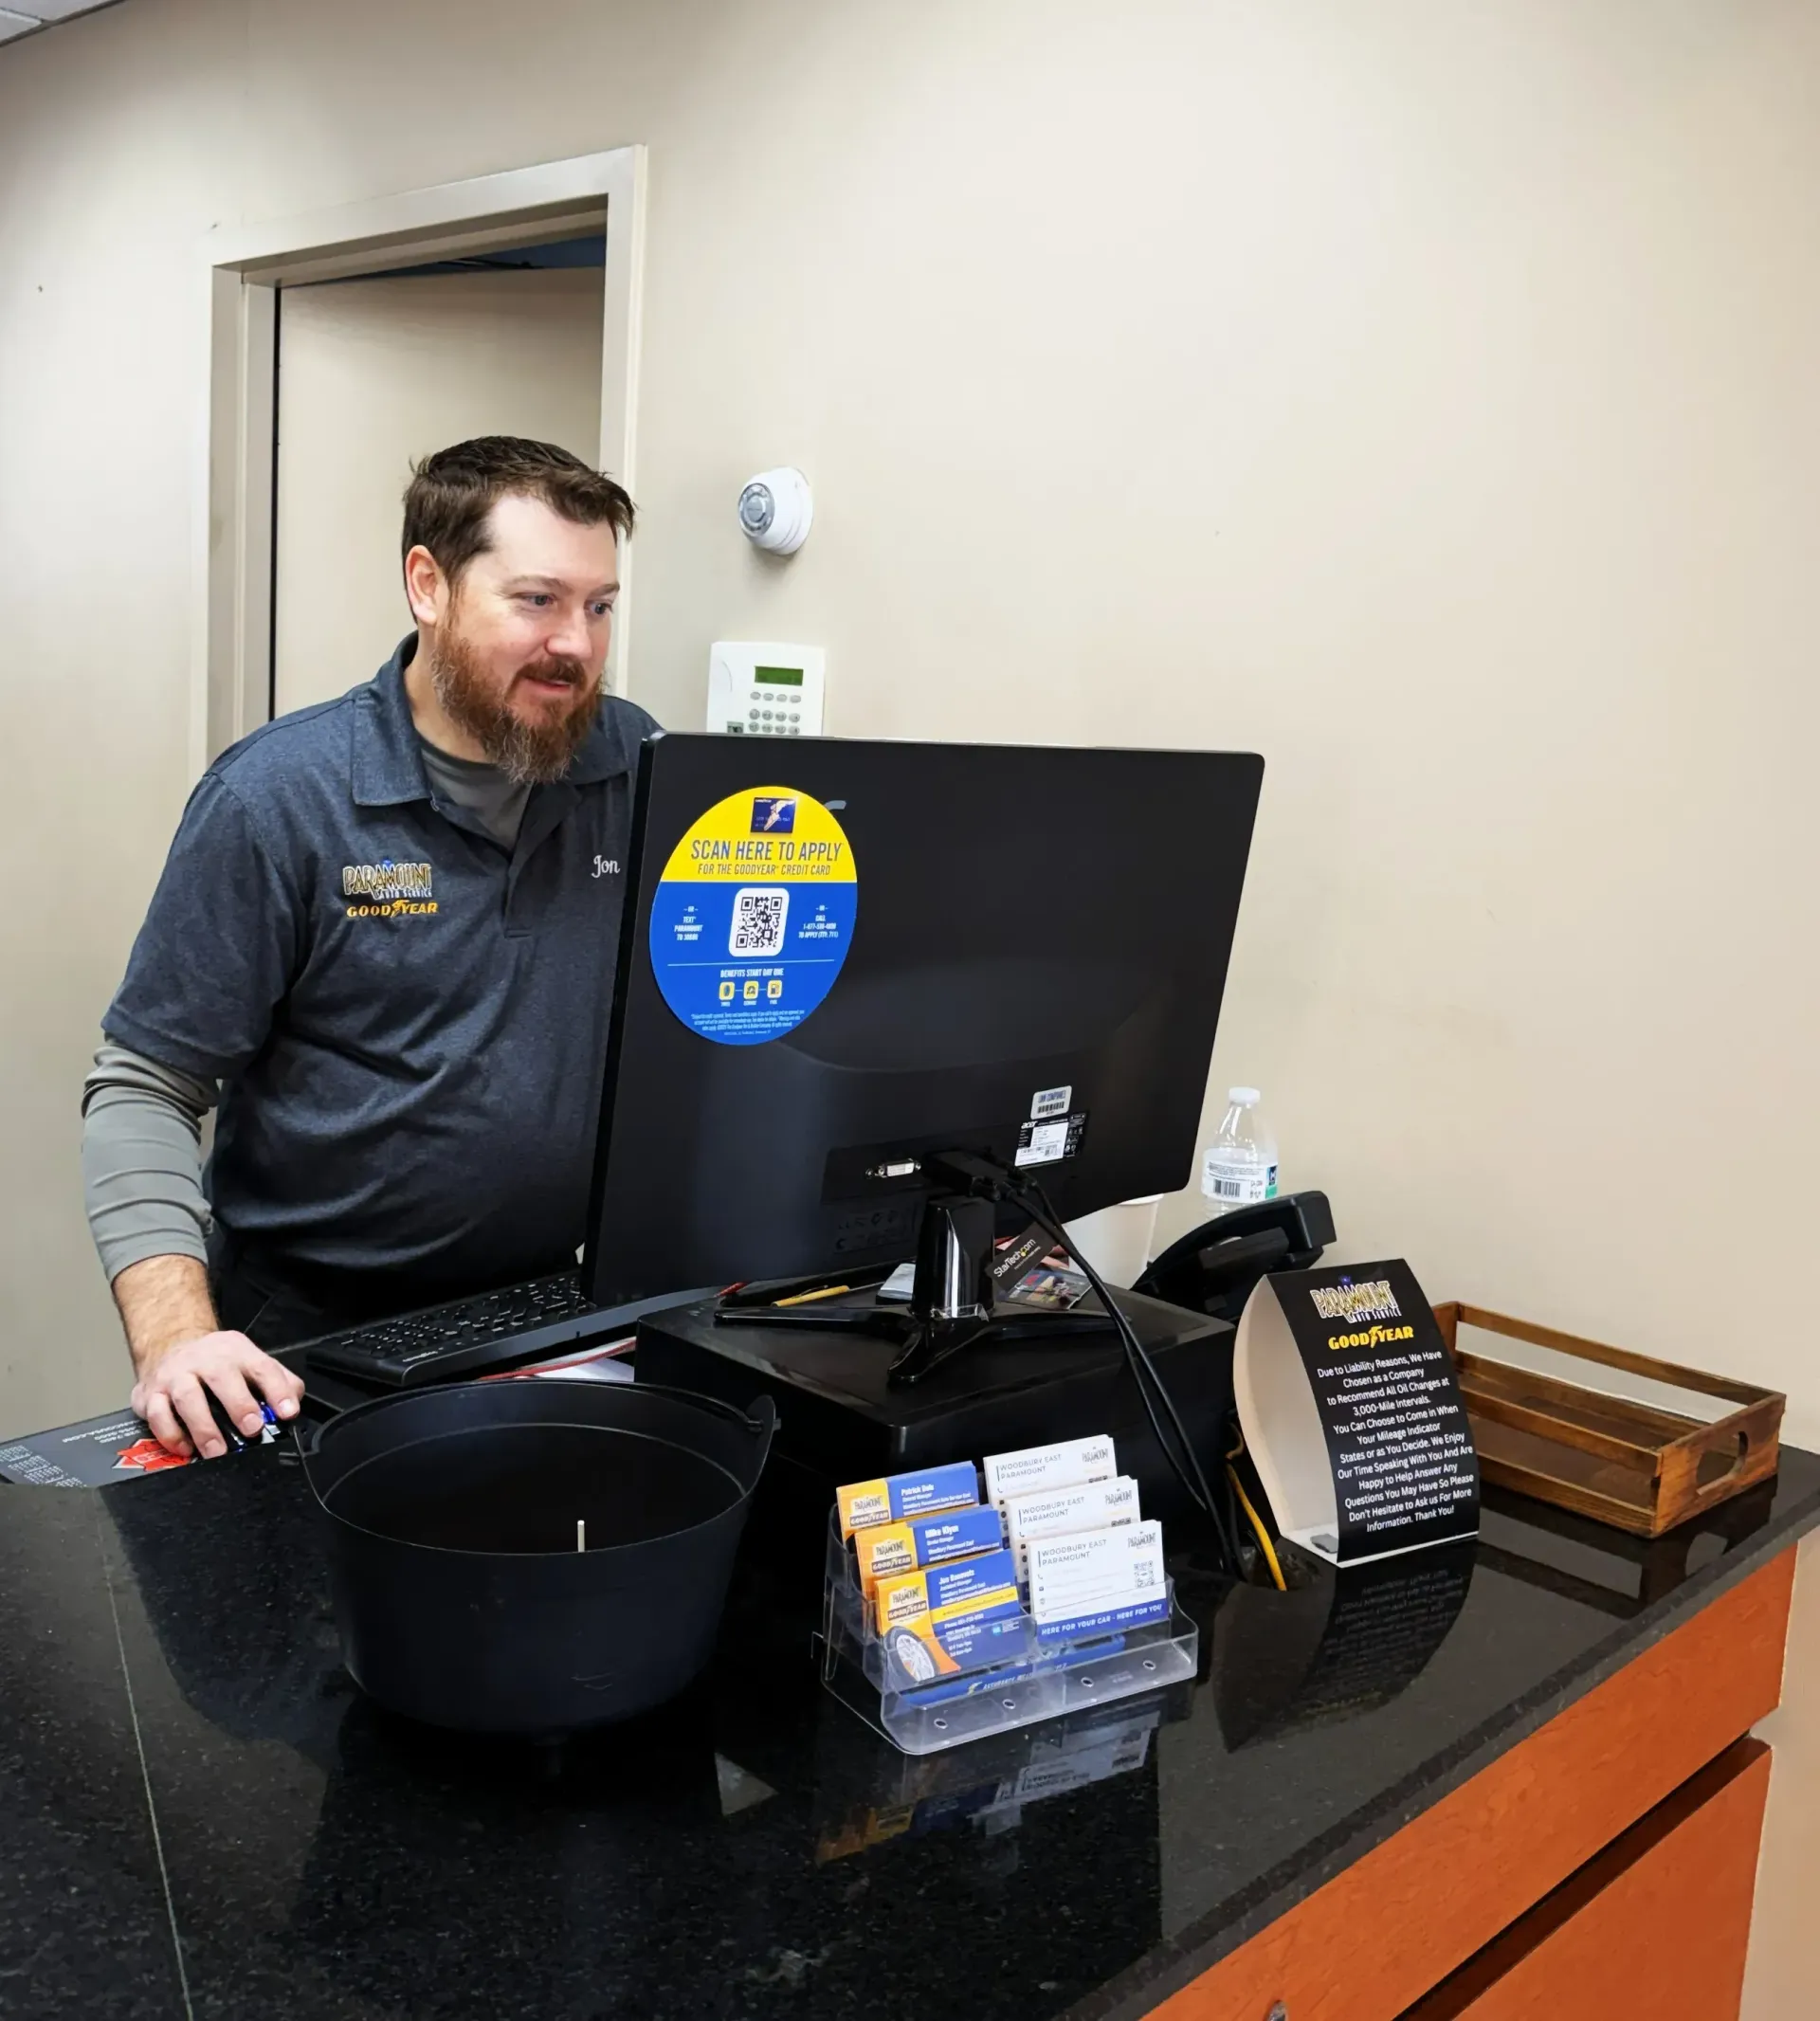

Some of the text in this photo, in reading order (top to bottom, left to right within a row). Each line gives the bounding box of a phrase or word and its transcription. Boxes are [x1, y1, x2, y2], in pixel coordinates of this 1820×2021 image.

[691, 840, 842, 861] SCAN HERE TO APPLY
[592, 855, 620, 878] Jon
[698, 864, 714, 875] FOR
[718, 865, 731, 875] THE
[781, 865, 809, 875] CREDIT
[810, 865, 830, 875] CARD
[343, 864, 432, 900] PARAMOUNT
[347, 900, 438, 918] GOODYEAR
[1310, 1281, 1399, 1324] PARAMOUNT
[1328, 1325, 1414, 1350] GOODYEAR
[1318, 1350, 1442, 1378] Due to Liability Reasons, We Have
[1343, 1376, 1372, 1388] Chosen
[1389, 1368, 1425, 1380] Company
[1327, 1377, 1449, 1406] to Recommend All Oil Changes at
[1353, 1394, 1431, 1417] 3,000-Mile Intervals.
[1334, 1405, 1458, 1435] You Can Choose to Come in When
[1357, 1422, 1441, 1445] Your Mileage Indicator
[1340, 1451, 1365, 1464] States
[1367, 1450, 1374, 1459] or
[1386, 1445, 1401, 1454] You
[1402, 1439, 1430, 1452] Decide.
[1430, 1437, 1443, 1447] We
[1445, 1432, 1465, 1445] Enjoy
[1000, 1454, 1062, 1470] WOODBURY EAST
[1001, 1466, 1046, 1479] PARAMOUNT
[1338, 1445, 1473, 1480] Our Time Speaking With You And Are
[1358, 1463, 1457, 1490] Happy to Help Answer Any
[1345, 1473, 1474, 1509] Questions You May Have So Please
[1022, 1497, 1084, 1514] WOODBURY EAST
[1024, 1509, 1068, 1523] PARAMOUNT
[1349, 1510, 1370, 1522] Don't
[1372, 1503, 1403, 1517] Hesitate
[1405, 1502, 1413, 1511] to
[1414, 1498, 1428, 1508] Ask
[1439, 1492, 1450, 1502] For
[1452, 1488, 1472, 1500] More
[1367, 1505, 1454, 1532] Information. Thank You!
[1043, 1539, 1106, 1557] WOODBURY EAST
[1043, 1552, 1090, 1565] PARAMOUNT
[888, 1602, 926, 1619] GOODYEAR
[1042, 1626, 1060, 1635] HERE
[1078, 1619, 1095, 1628] YOUR
[1097, 1615, 1111, 1624] CAR
[1117, 1611, 1133, 1620] HERE
[1135, 1608, 1147, 1616] FOR
[1150, 1604, 1162, 1612] YOU
